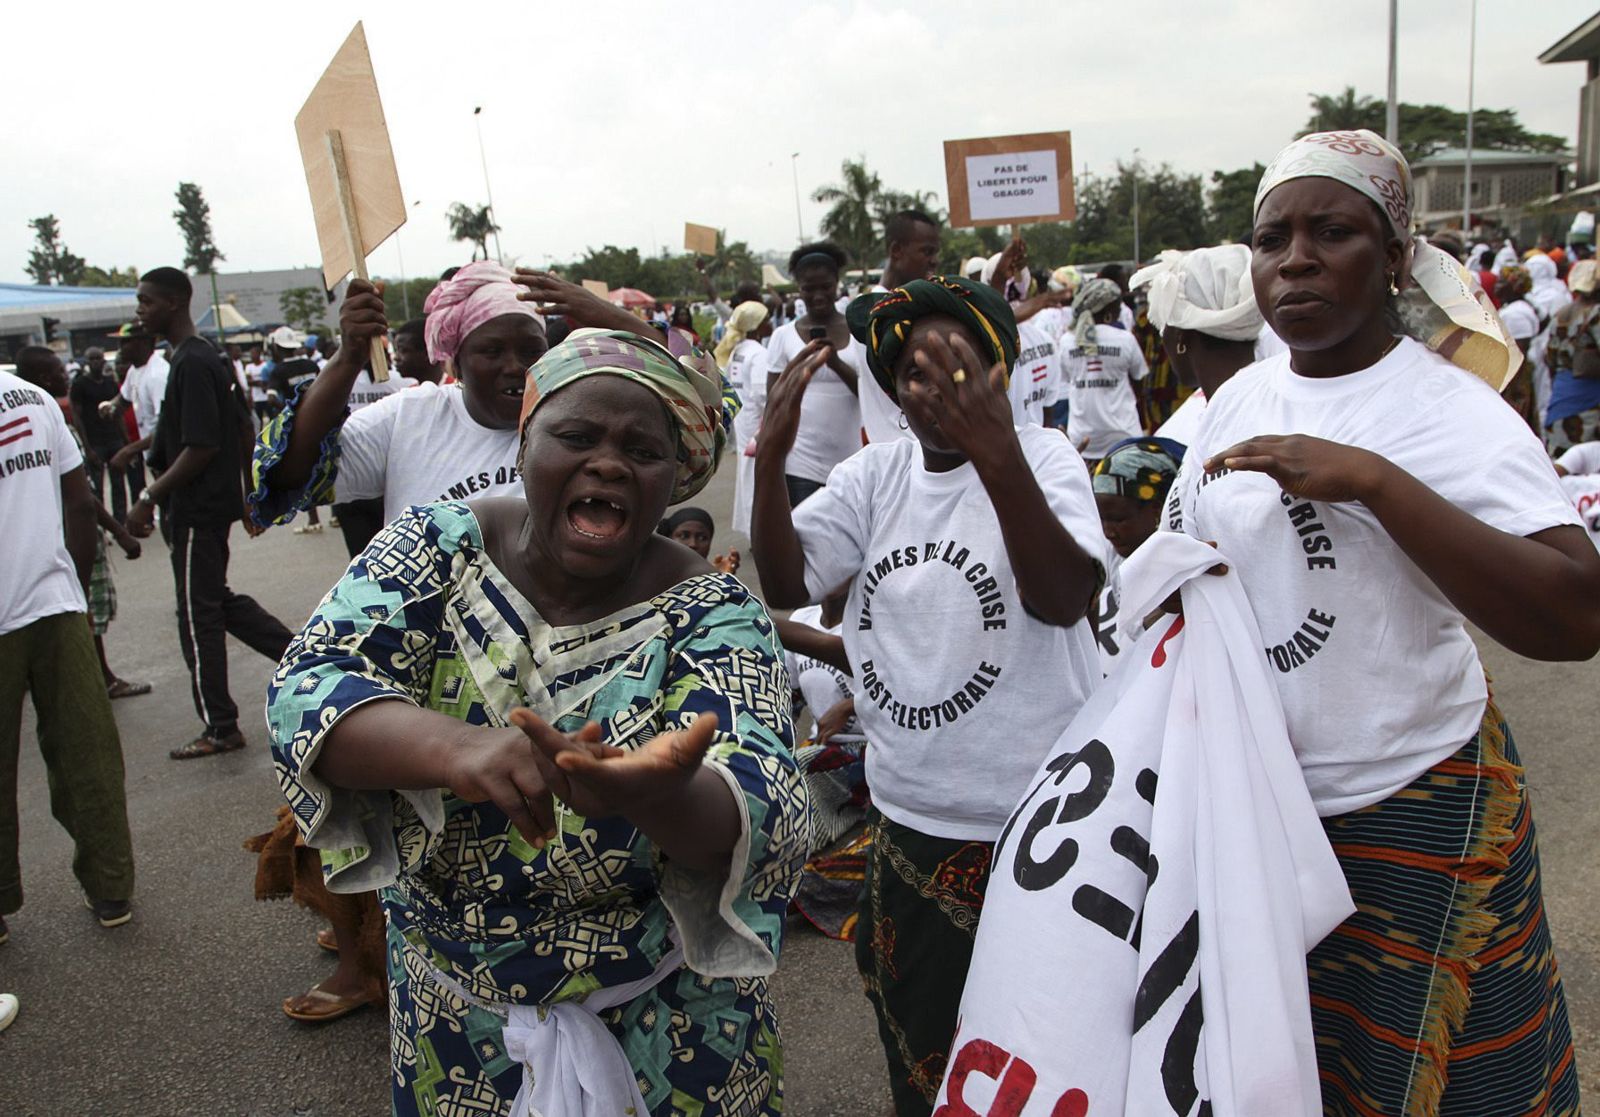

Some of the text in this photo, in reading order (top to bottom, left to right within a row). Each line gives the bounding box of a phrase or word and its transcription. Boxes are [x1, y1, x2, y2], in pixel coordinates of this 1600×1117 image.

[977, 175, 1048, 187] LIBERTE POUR
[993, 188, 1034, 197] GBAGBO
[858, 540, 1006, 631] VICTIMES DE LA CRISE
[861, 659, 1001, 731] POST-ELECTORALE
